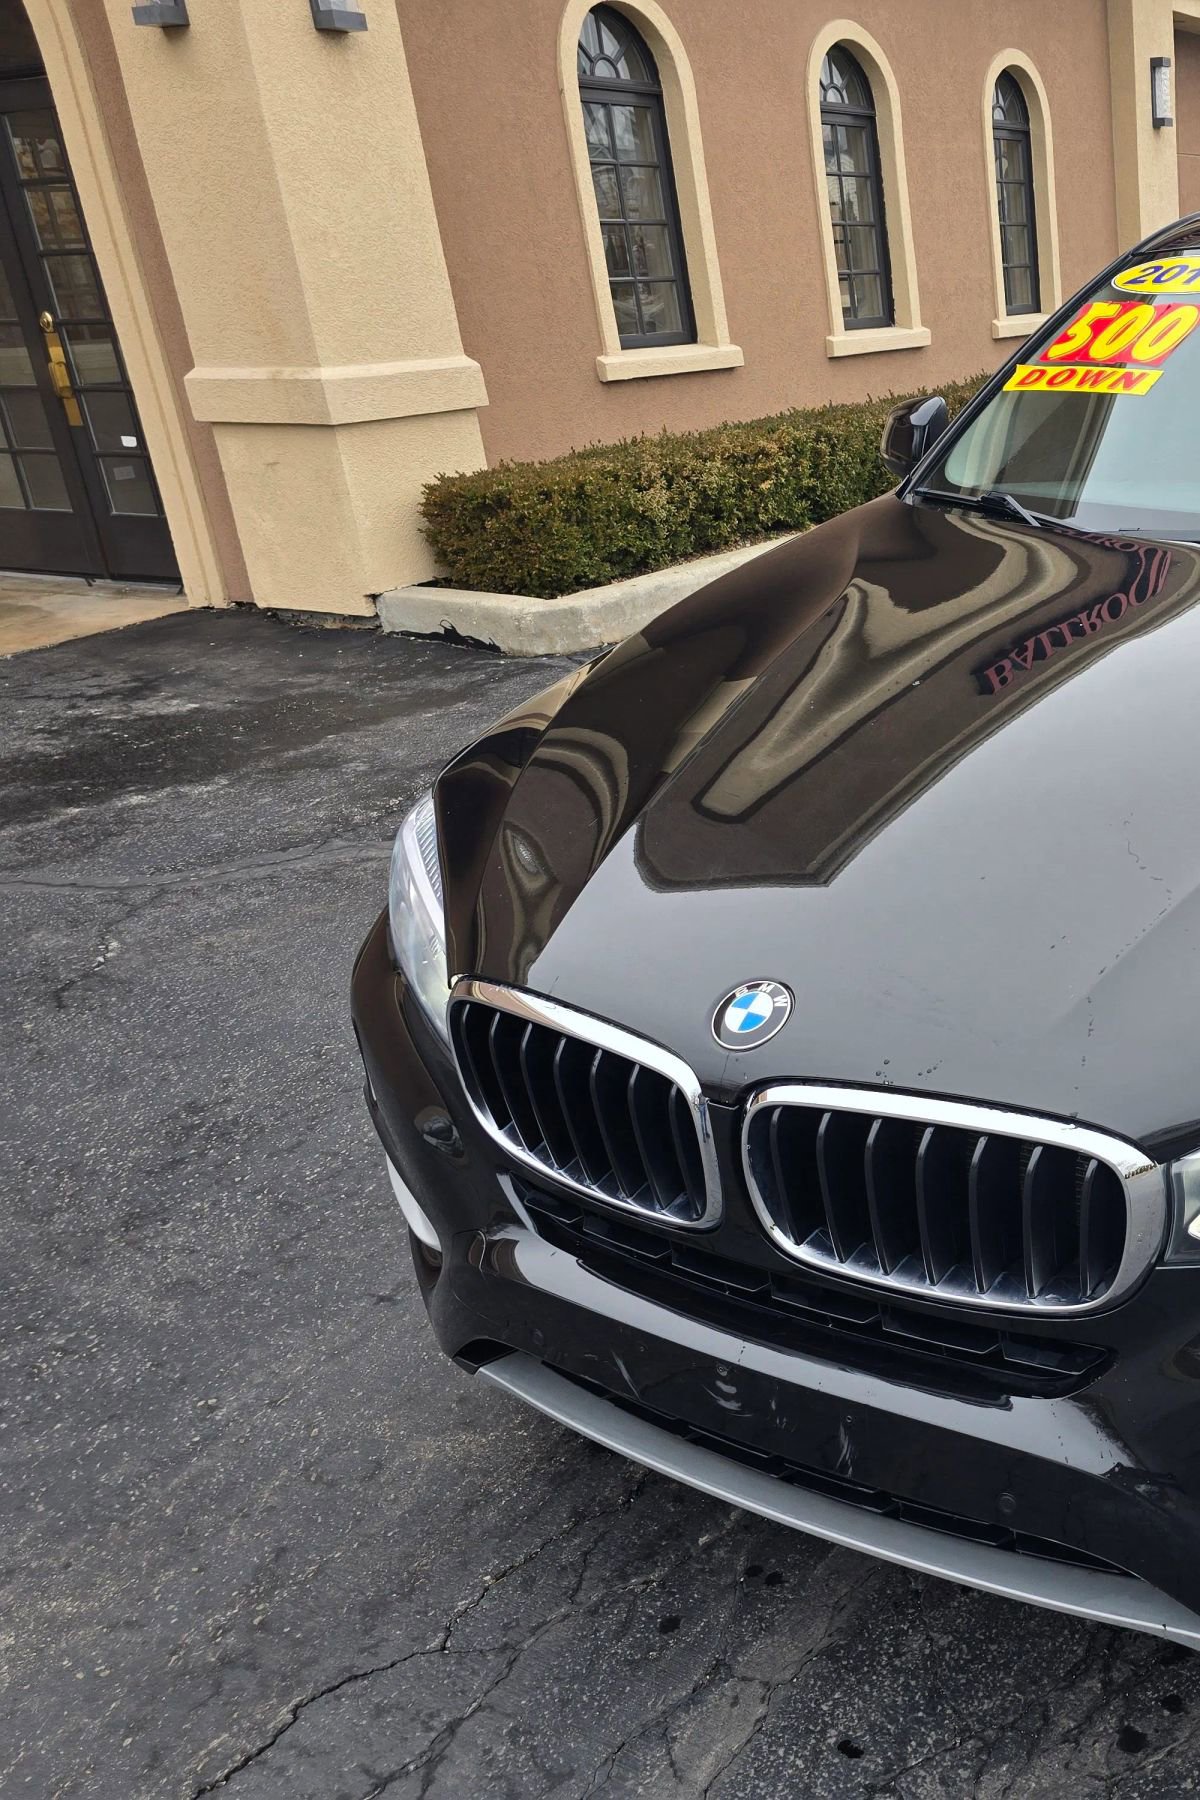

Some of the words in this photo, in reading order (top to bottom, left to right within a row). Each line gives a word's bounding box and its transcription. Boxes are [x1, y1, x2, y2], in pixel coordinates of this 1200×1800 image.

[1047, 301, 1200, 361] 500
[1015, 368, 1150, 391] DOWN
[735, 983, 788, 1007] BMW
